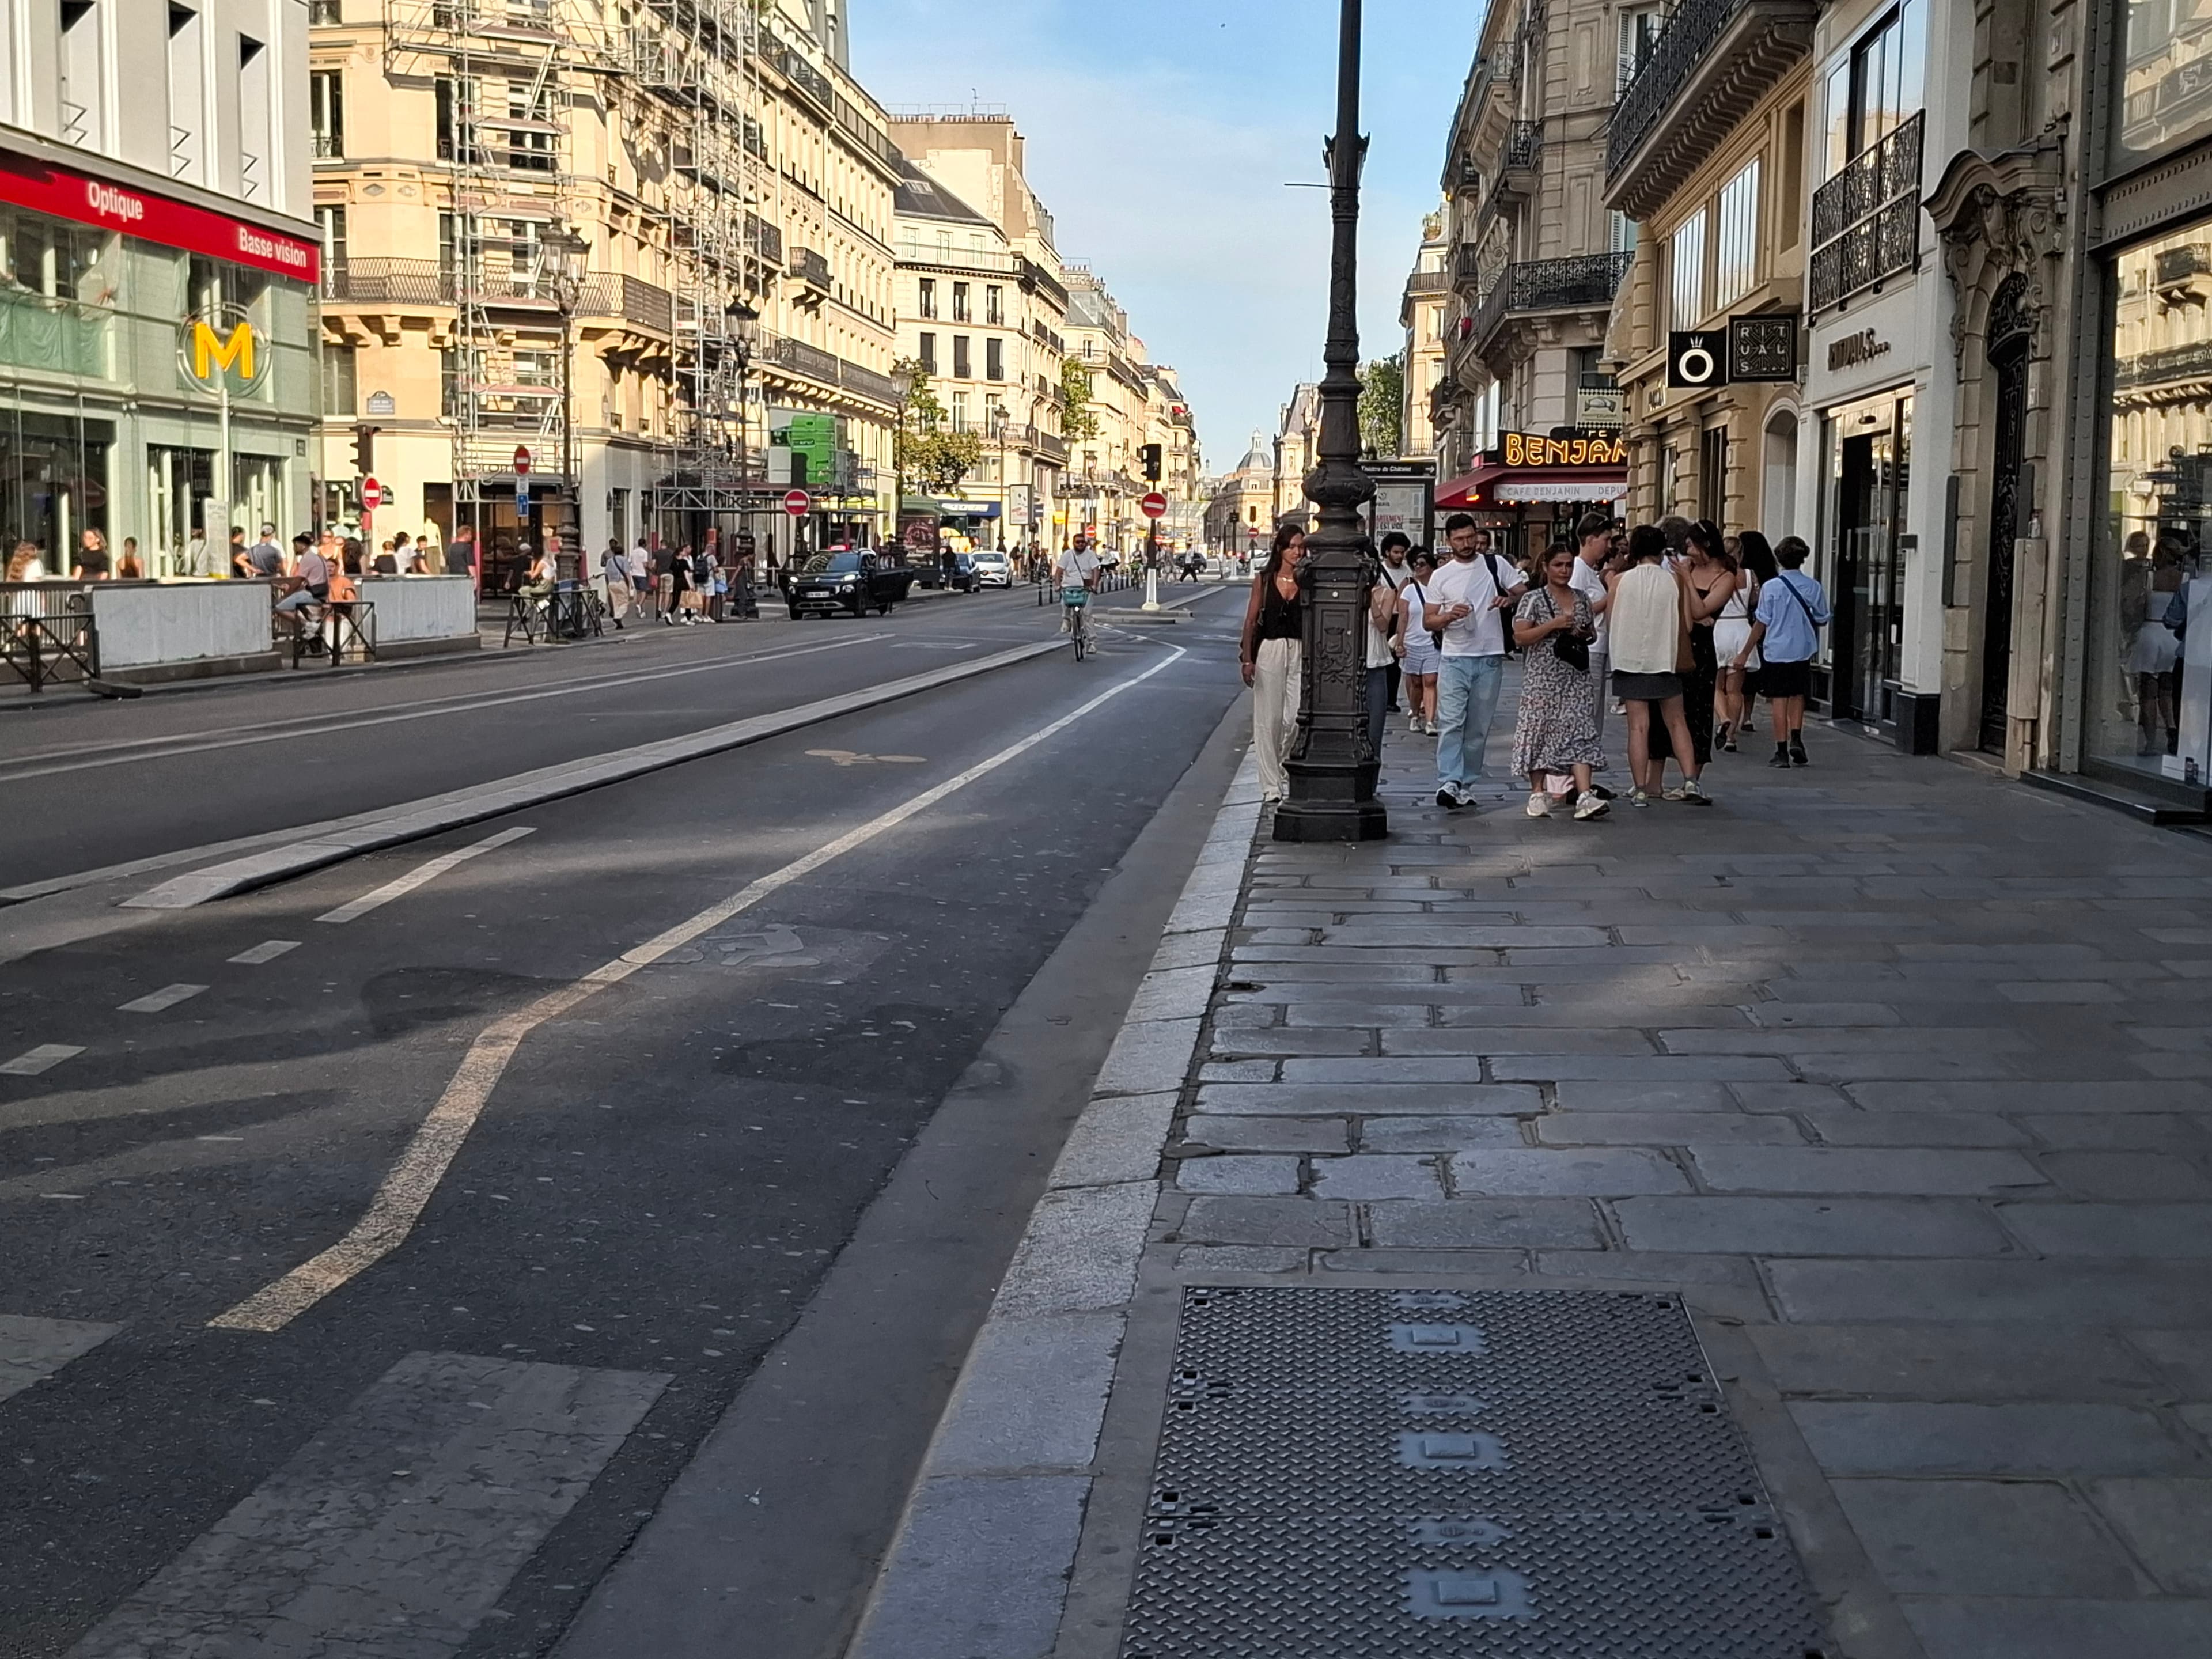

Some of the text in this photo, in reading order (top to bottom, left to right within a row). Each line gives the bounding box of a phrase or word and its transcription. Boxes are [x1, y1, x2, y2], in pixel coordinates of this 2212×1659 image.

[88, 181, 143, 222] Optique
[238, 227, 307, 268] Basse vision
[194, 321, 254, 379] M
[1533, 486, 1580, 496] BENJAMIN
